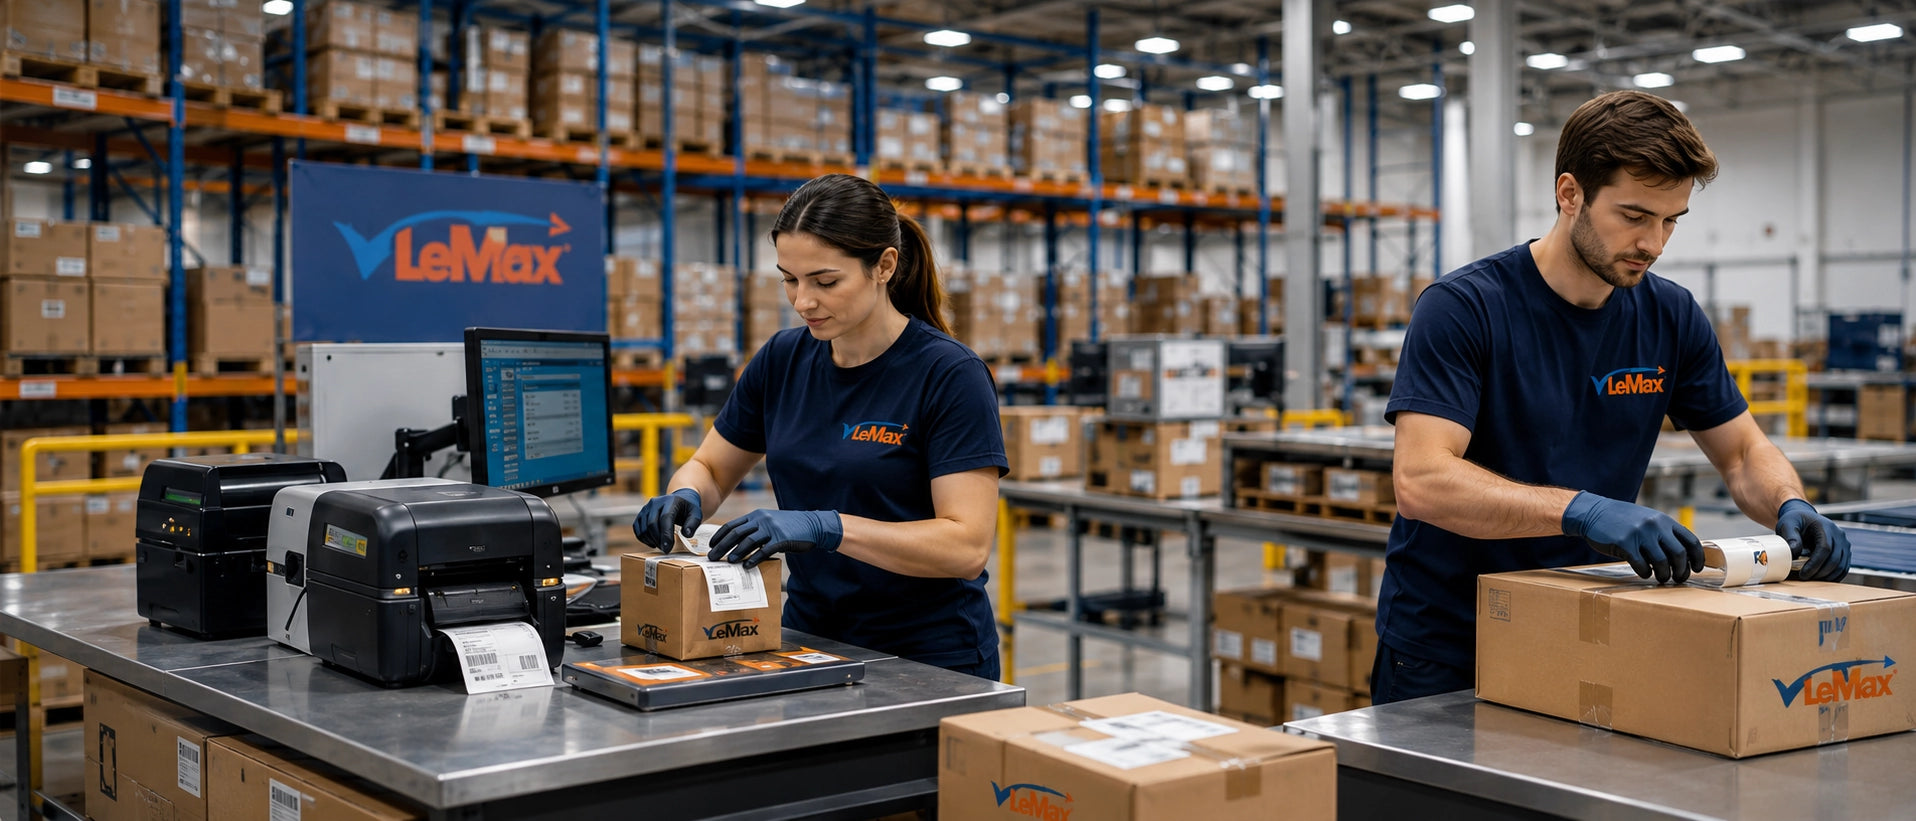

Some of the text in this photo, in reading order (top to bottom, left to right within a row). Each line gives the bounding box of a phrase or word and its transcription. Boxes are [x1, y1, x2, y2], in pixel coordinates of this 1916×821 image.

[395, 224, 564, 285] LeMax
[1607, 373, 1664, 395] LeMax
[851, 425, 904, 446] LeMax
[708, 622, 759, 641] LeMax
[1803, 667, 1893, 706] LeMax
